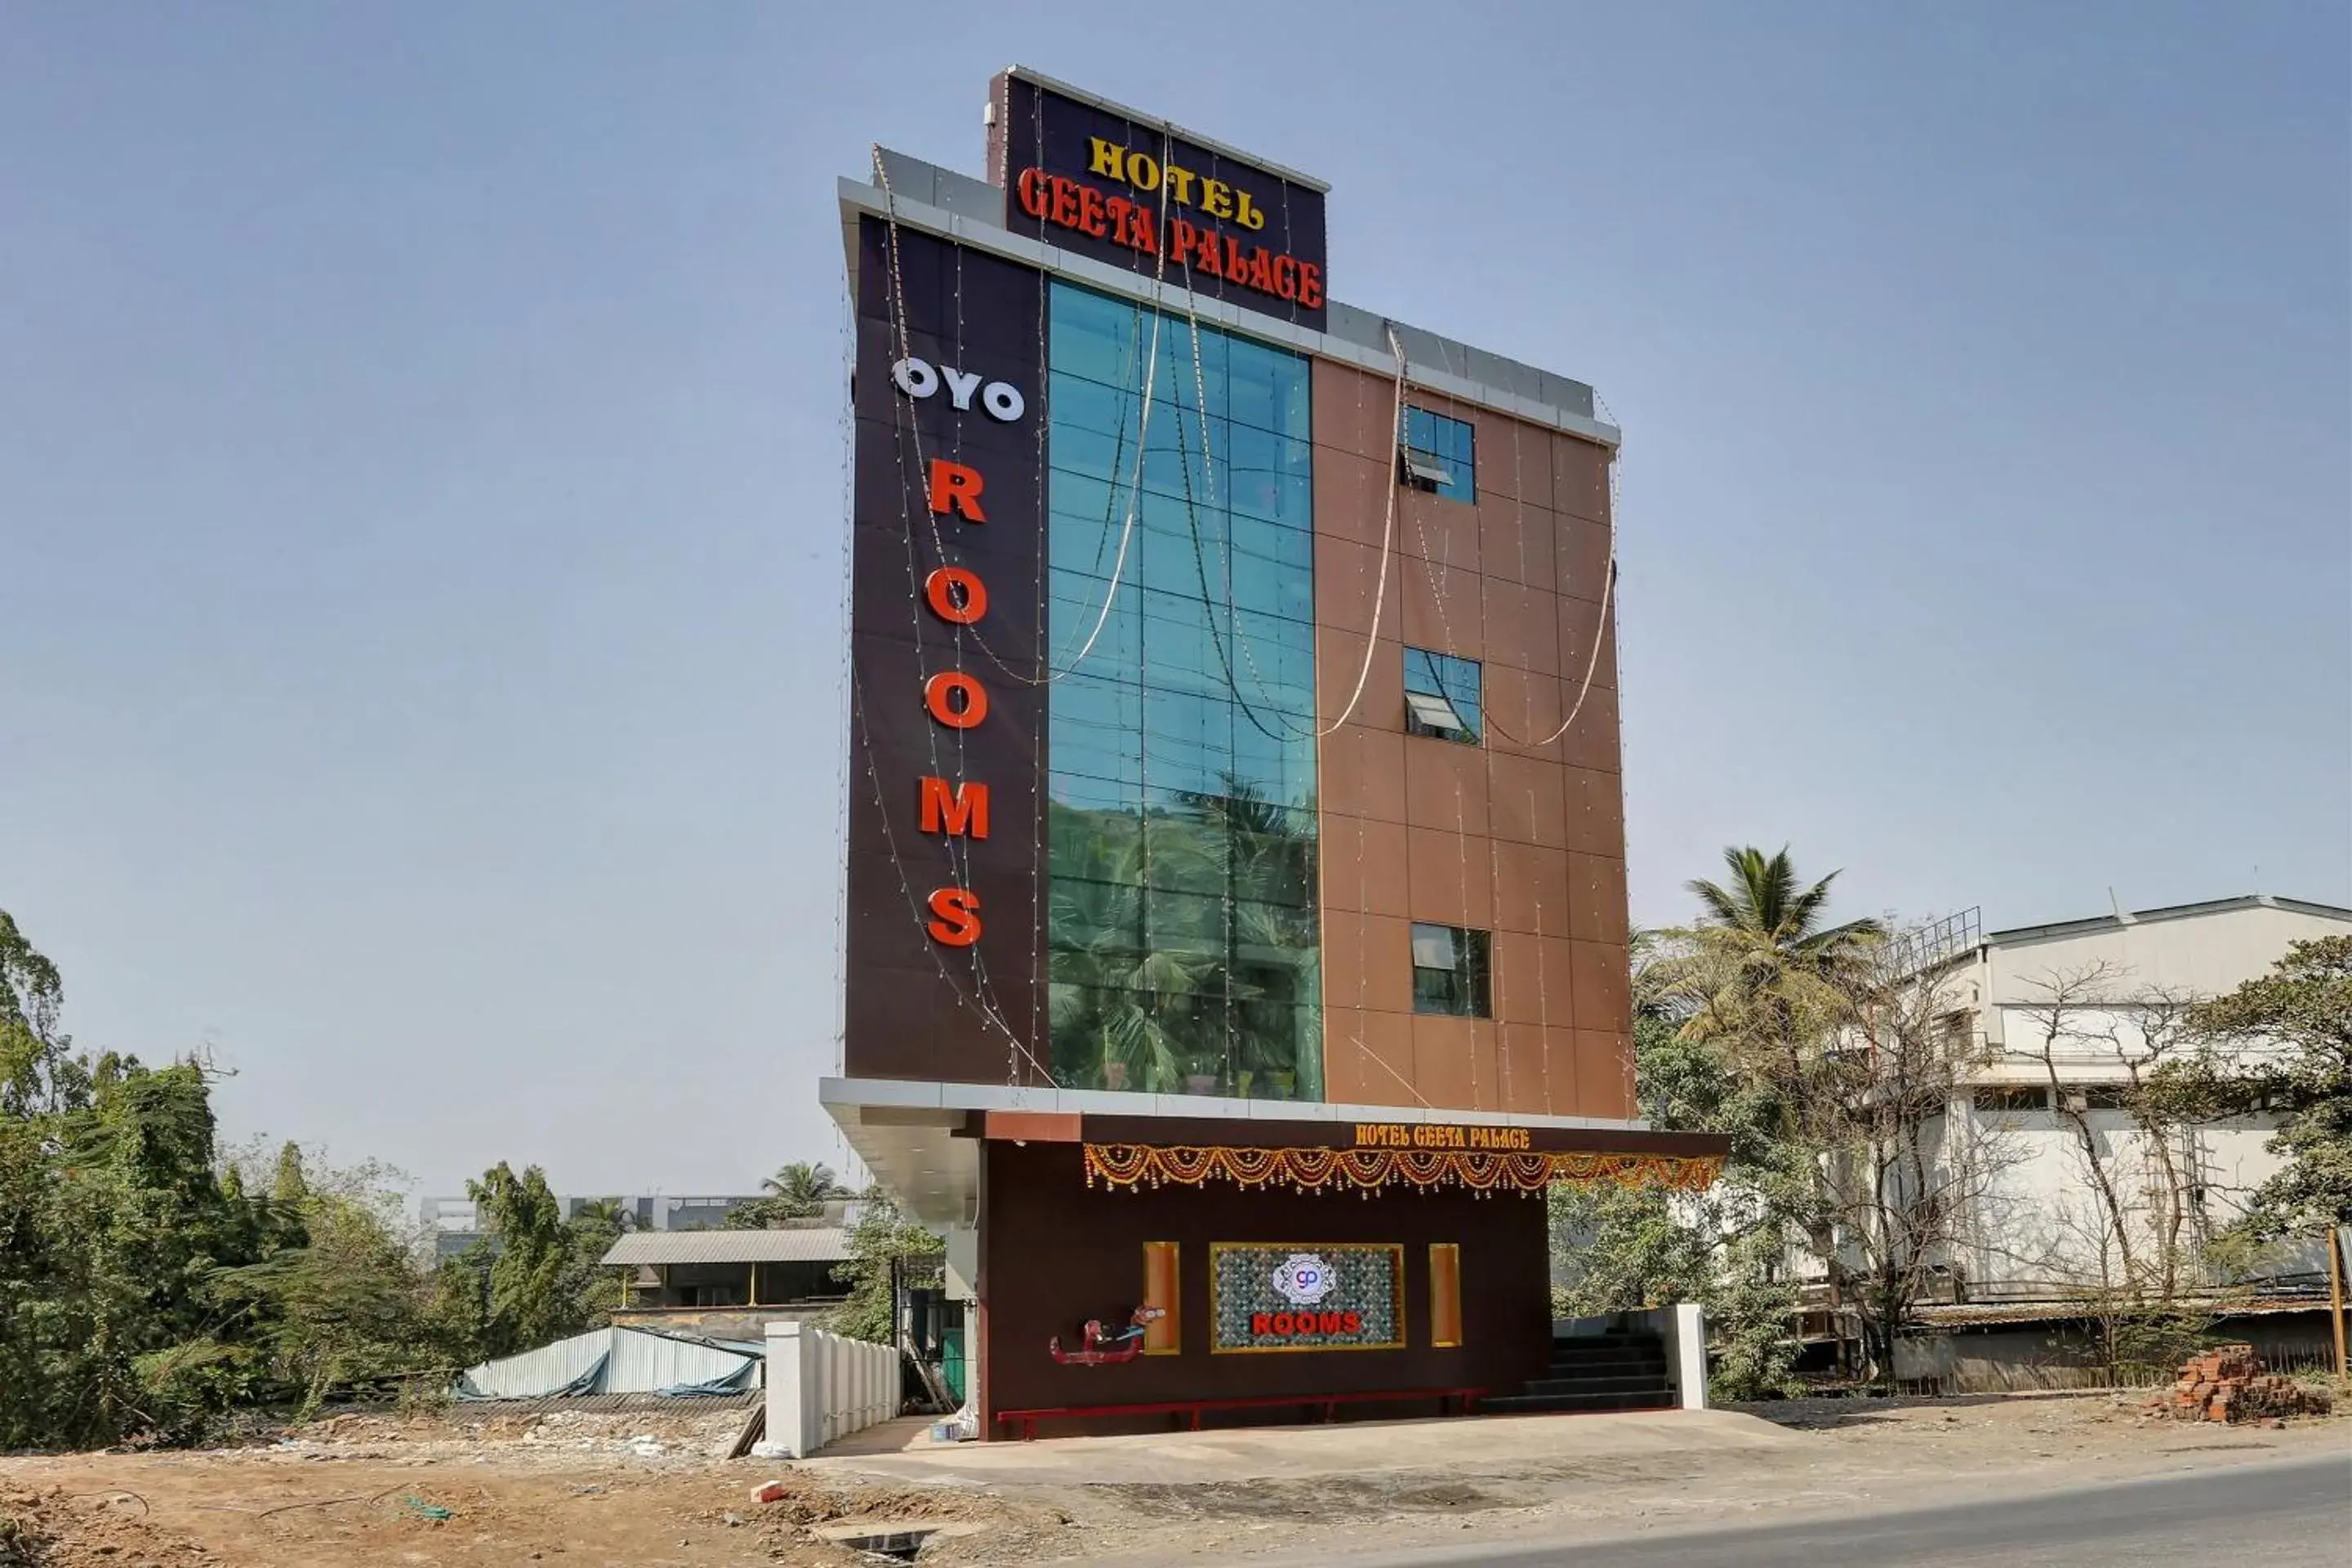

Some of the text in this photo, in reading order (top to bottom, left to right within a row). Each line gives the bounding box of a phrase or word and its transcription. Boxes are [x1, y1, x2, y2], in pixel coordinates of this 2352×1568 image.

[1089, 136, 1265, 230] HOTEL
[1018, 167, 1323, 309] GEETA PALACE
[893, 357, 1025, 421] OYO
[920, 457, 988, 946] ROOMS
[1356, 1124, 1530, 1150] HOTEL GEETA PALACE
[1253, 1311, 1361, 1334] ROOMS
